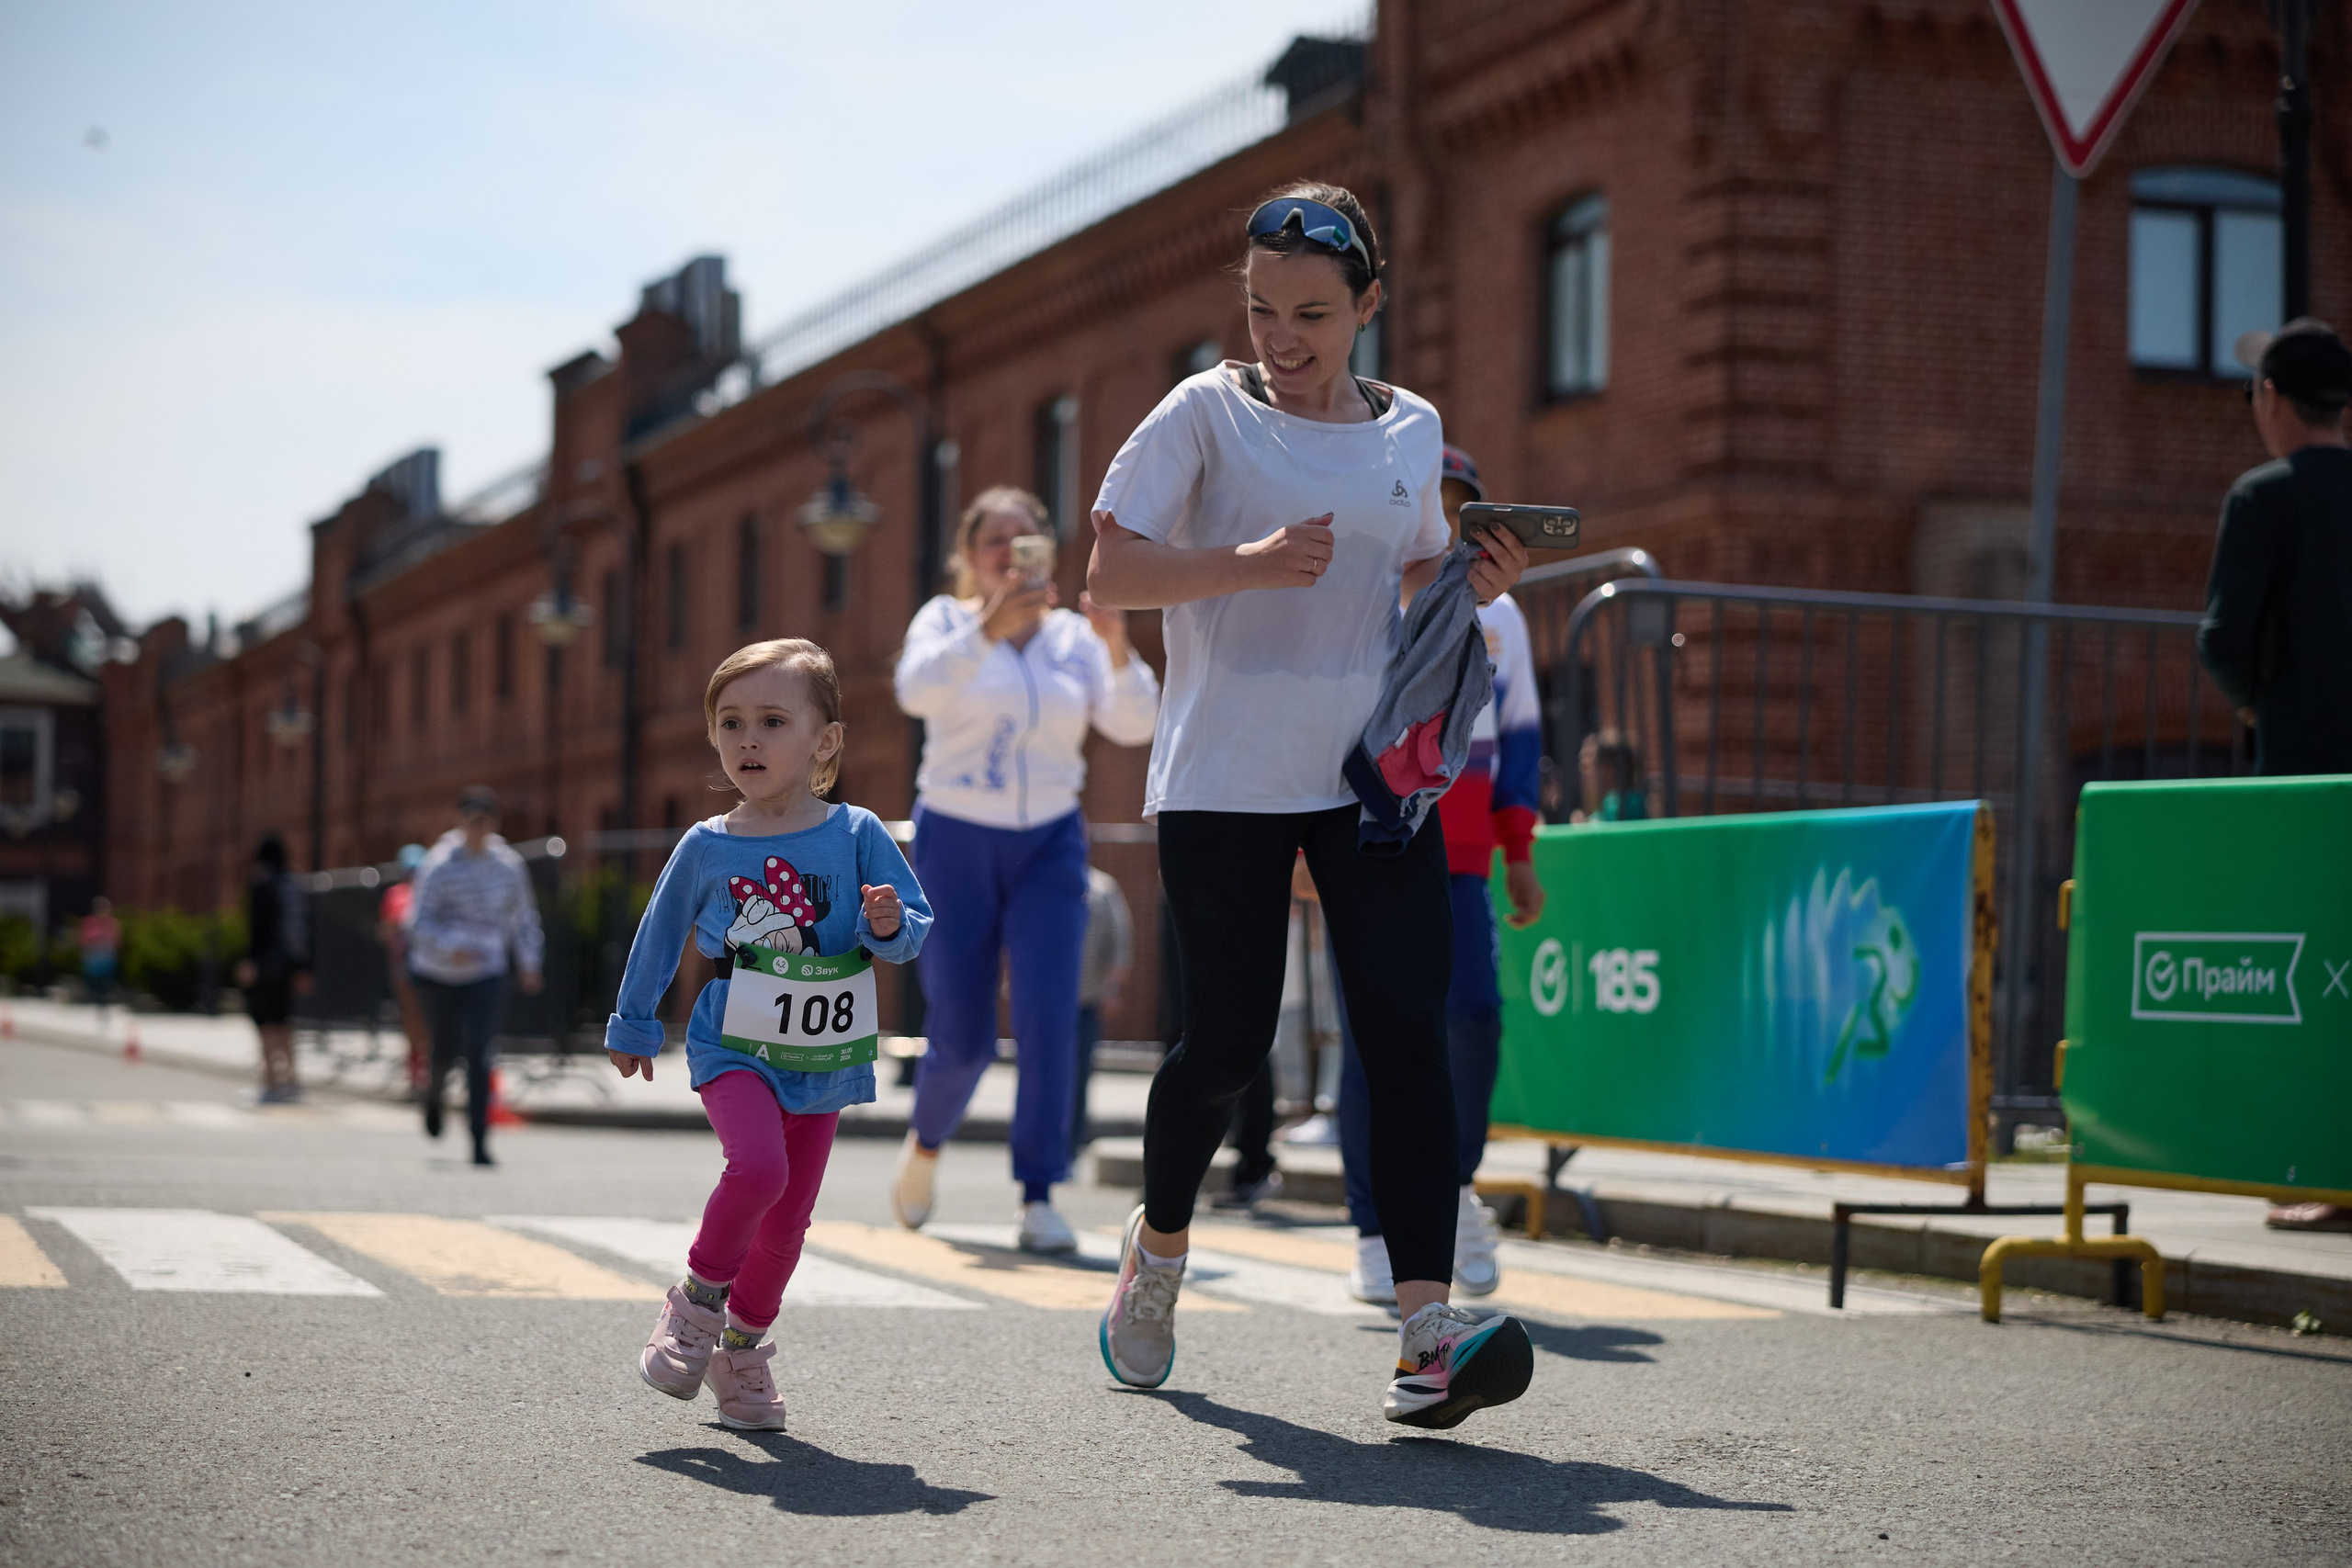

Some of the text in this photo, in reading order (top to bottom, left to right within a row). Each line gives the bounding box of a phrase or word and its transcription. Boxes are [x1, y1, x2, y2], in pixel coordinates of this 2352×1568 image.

[815, 966, 839, 976] Звук
[1588, 947, 1661, 1014] 185
[2183, 956, 2276, 1001] Прайм
[775, 991, 854, 1036] 108
